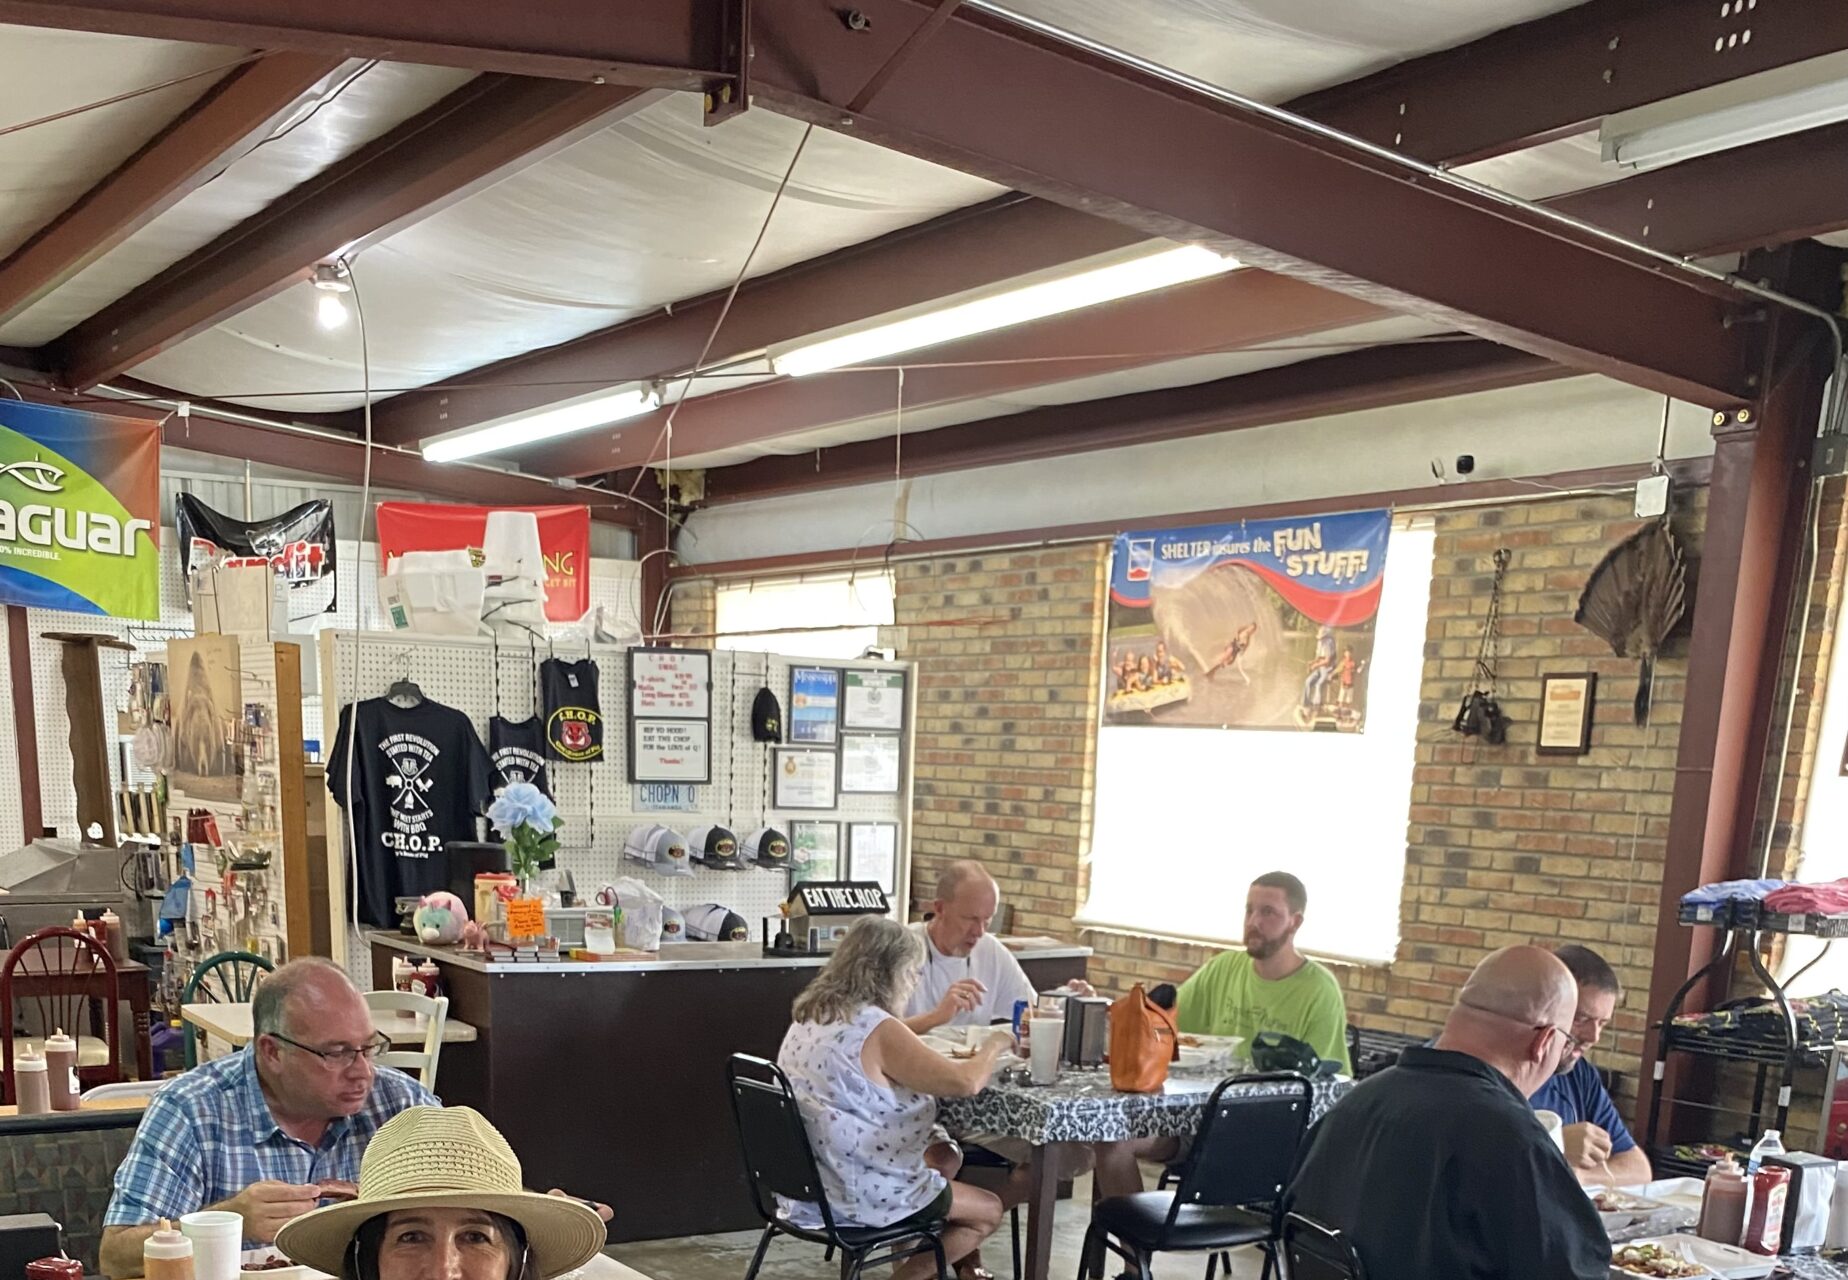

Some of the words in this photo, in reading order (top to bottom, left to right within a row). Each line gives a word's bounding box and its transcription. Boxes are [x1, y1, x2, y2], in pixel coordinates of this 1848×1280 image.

[1161, 540, 1211, 560] SHELTER
[1213, 539, 1250, 555] insures
[1253, 537, 1271, 553] the
[1273, 522, 1322, 559] FUN
[1286, 549, 1370, 581] STUFF!
[386, 743, 408, 758] STARTED
[408, 743, 423, 757] WITH
[422, 749, 434, 763] TEA
[389, 733, 405, 745] FIRST
[405, 733, 440, 757] REVOLUTION
[496, 756, 516, 771] STARTED
[516, 756, 531, 768] WITH
[529, 760, 540, 773] TEA
[499, 746, 512, 757] FIRST
[512, 746, 545, 767] REVOLUTION
[393, 818, 410, 834] WITH
[410, 821, 427, 834] BBQ
[411, 809, 434, 824] STARTS
[802, 887, 828, 908] EAT
[823, 887, 851, 908] THE
